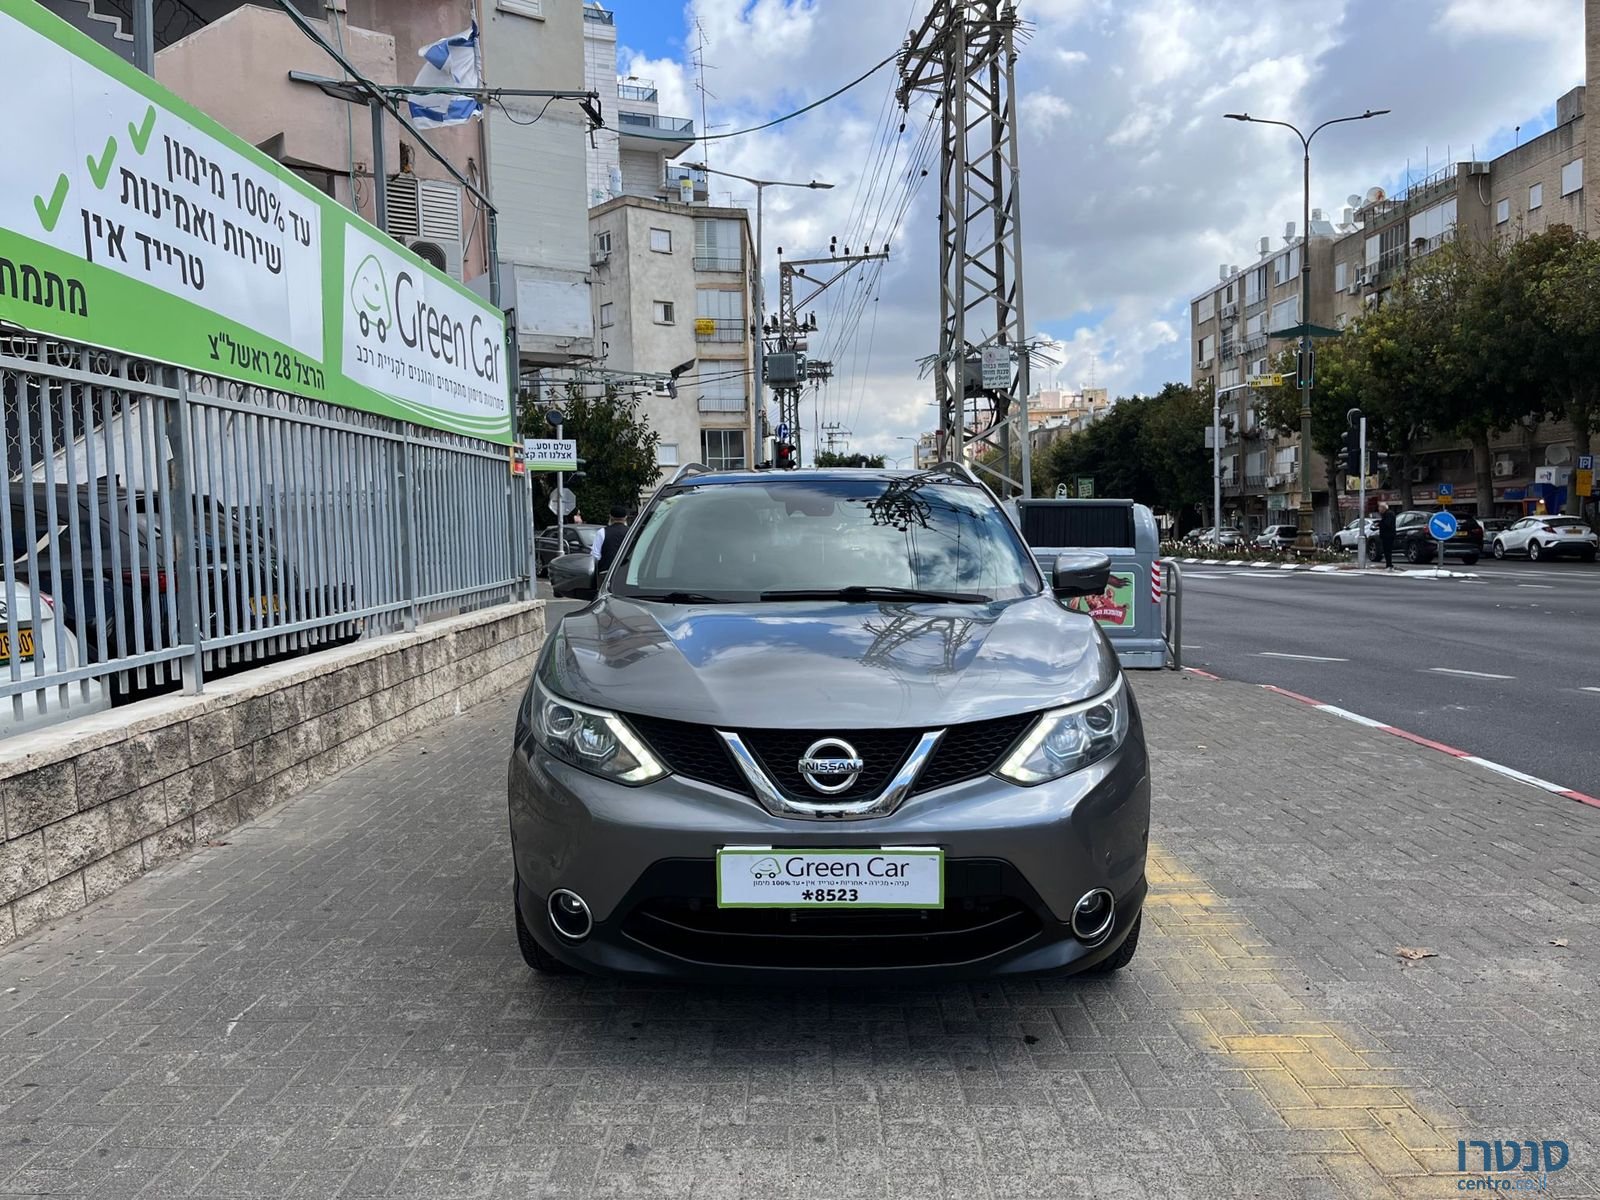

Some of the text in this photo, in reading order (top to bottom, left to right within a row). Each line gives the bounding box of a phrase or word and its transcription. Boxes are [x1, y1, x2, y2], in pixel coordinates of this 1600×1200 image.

[163, 134, 311, 247] עד 100% מימון
[119, 166, 282, 275] שירות ואמינות
[81, 208, 205, 291] טרייד אין
[394, 271, 500, 385] Green Car
[274, 350, 292, 381] 28
[356, 345, 375, 366] רכב
[377, 350, 406, 380] לקניית
[294, 355, 325, 391] הרצל
[408, 362, 435, 387] והוגנים
[437, 375, 467, 399] מתקדמים
[538, 451, 548, 459] זה
[550, 451, 572, 459] אצלנו
[553, 442, 572, 450] שלם
[804, 761, 857, 772] NISSAN
[785, 857, 910, 878] Green Car
